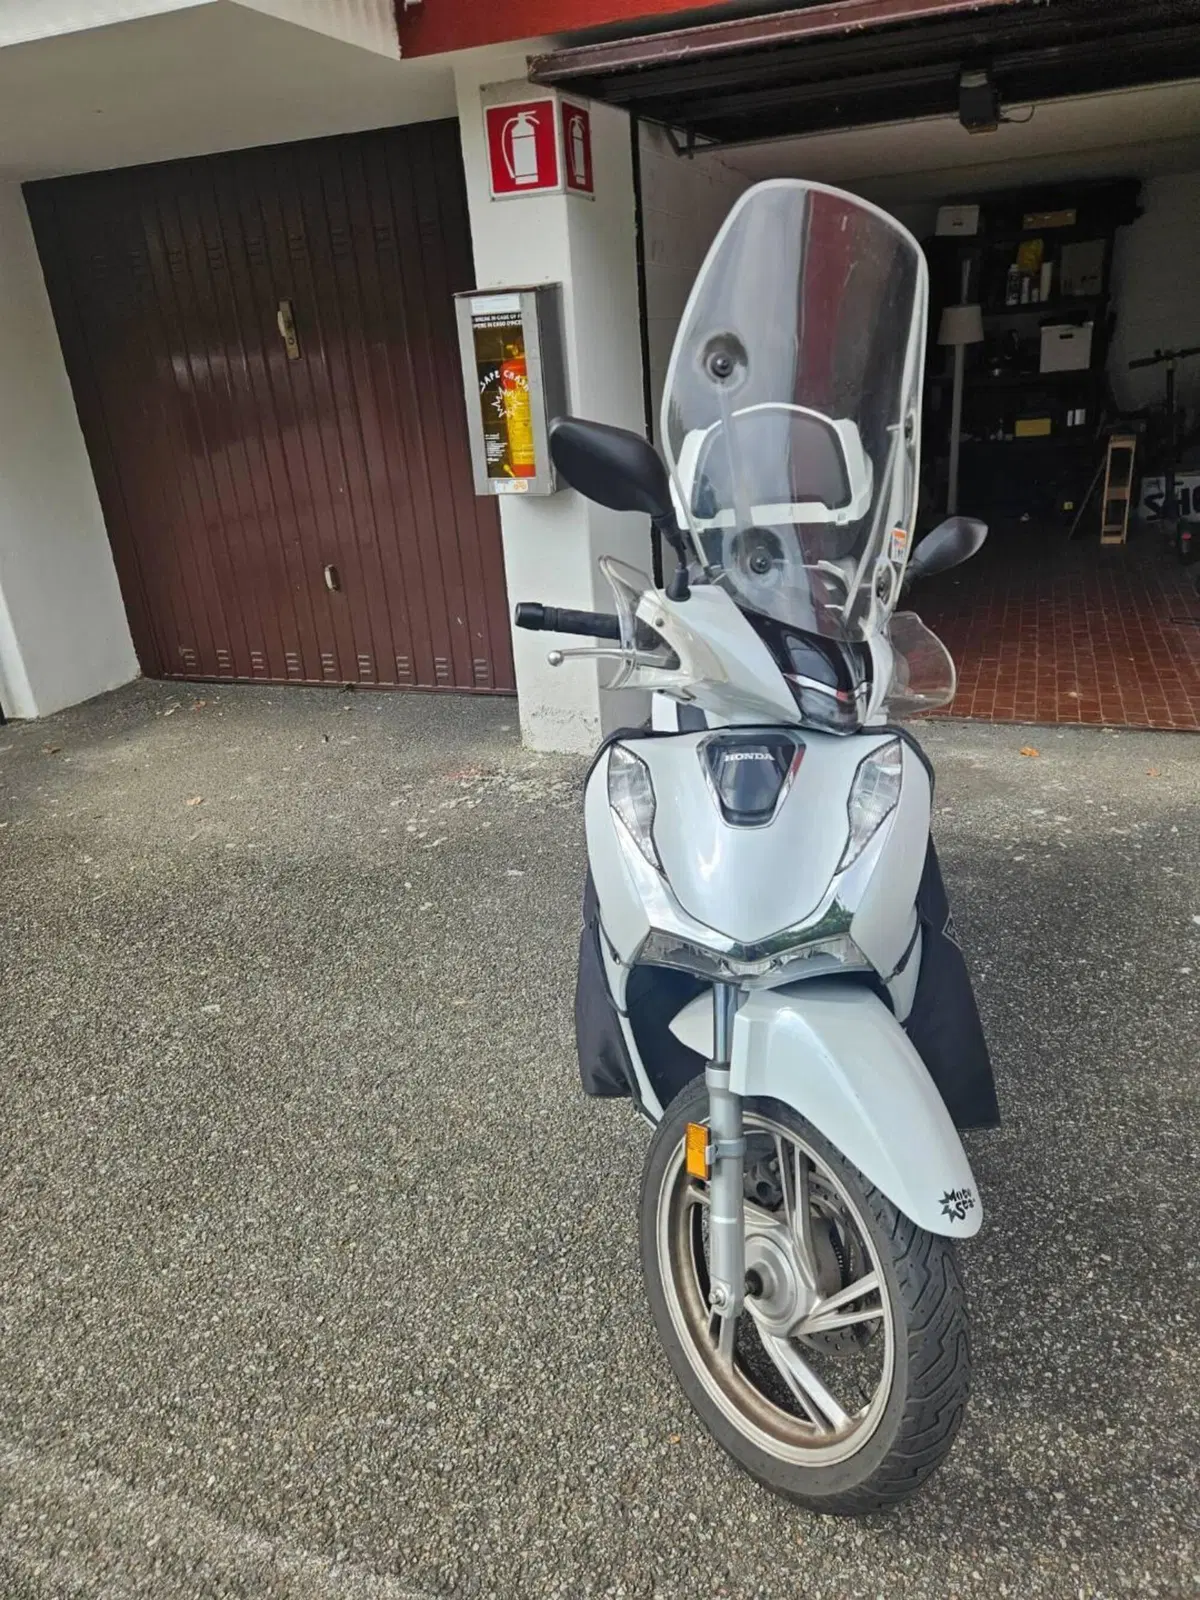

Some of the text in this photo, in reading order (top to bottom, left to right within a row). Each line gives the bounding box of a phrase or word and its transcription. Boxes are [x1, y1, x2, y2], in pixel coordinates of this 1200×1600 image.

[480, 370, 530, 394] SAFE CRASH
[724, 752, 776, 762] HONDA
